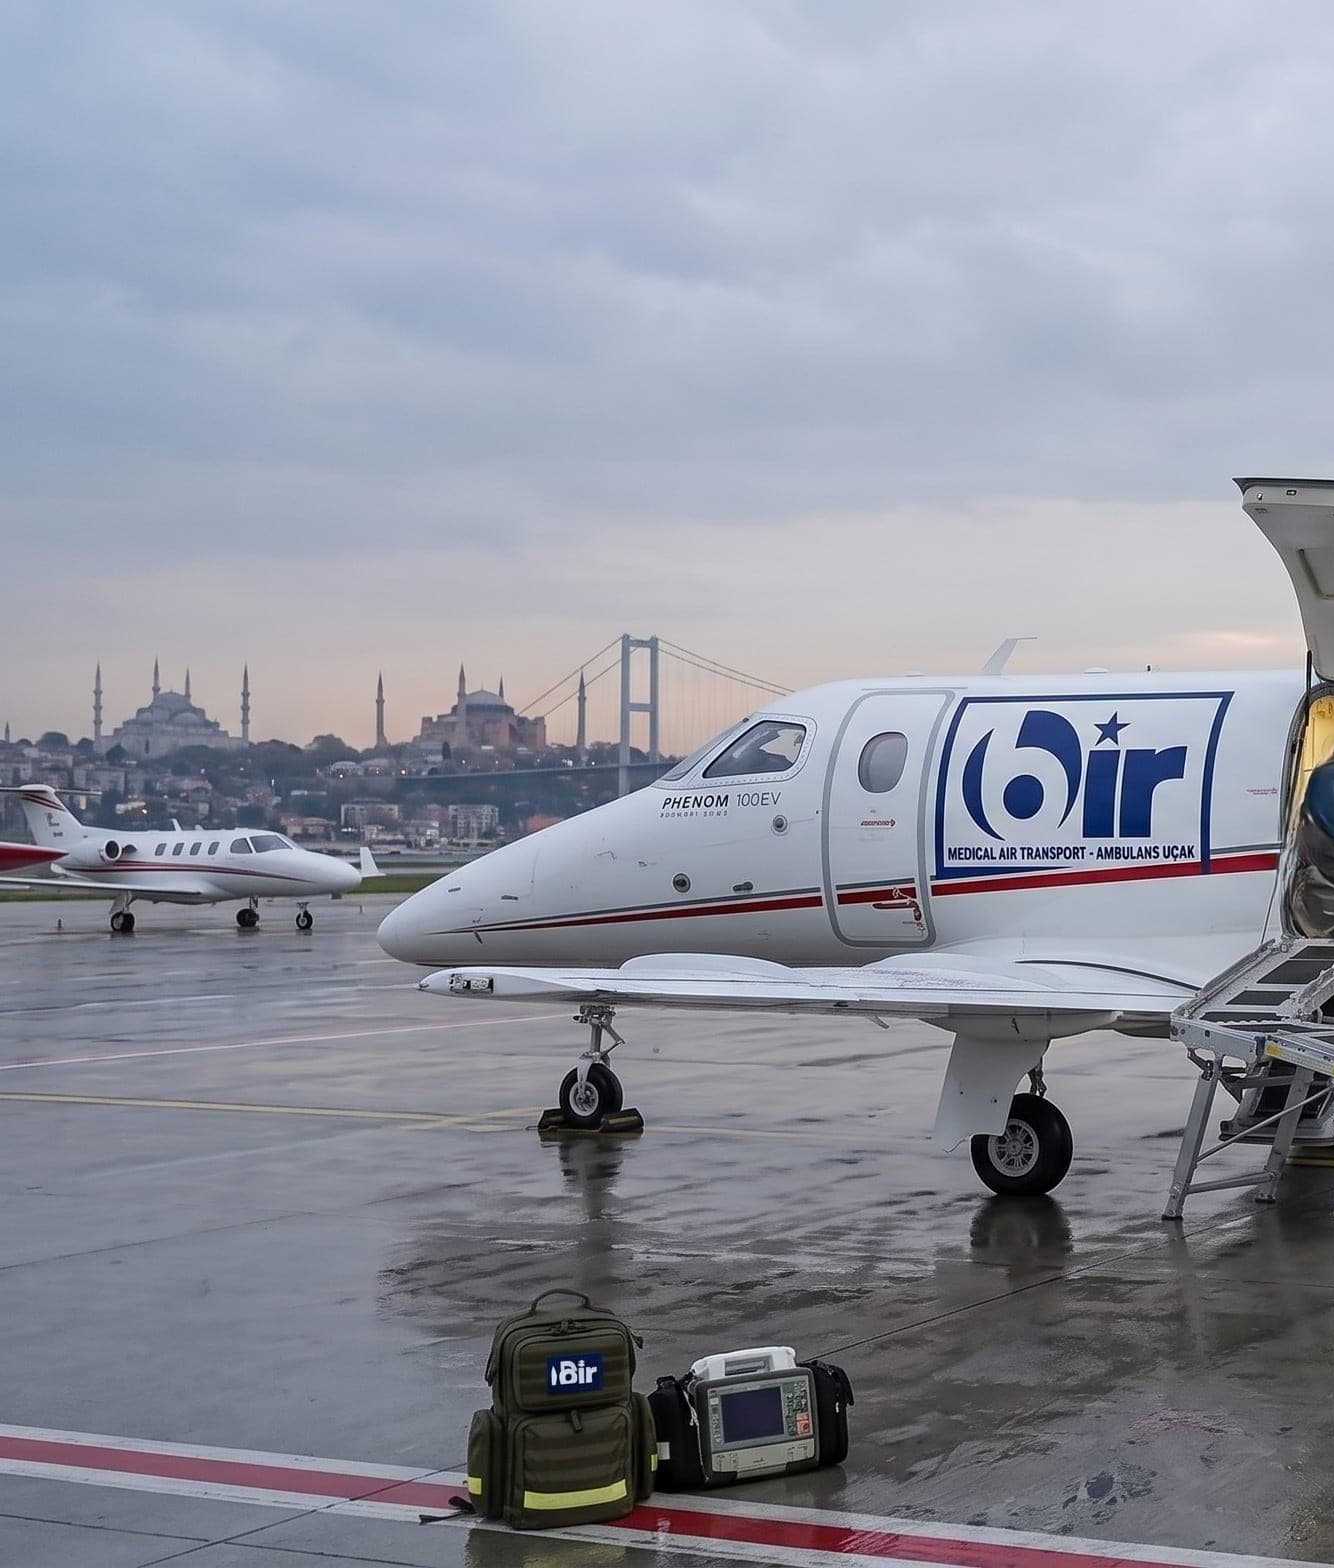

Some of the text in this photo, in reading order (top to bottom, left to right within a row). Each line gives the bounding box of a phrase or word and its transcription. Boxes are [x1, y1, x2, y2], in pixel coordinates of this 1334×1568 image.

[662, 791, 781, 809] PHENOM 100EV
[948, 847, 997, 861] MEDICAL
[998, 847, 1017, 861] AIR
[1020, 846, 1086, 860] TRANSPORT
[1096, 845, 1160, 859] AMBULANS
[1162, 844, 1195, 862] UÇAK
